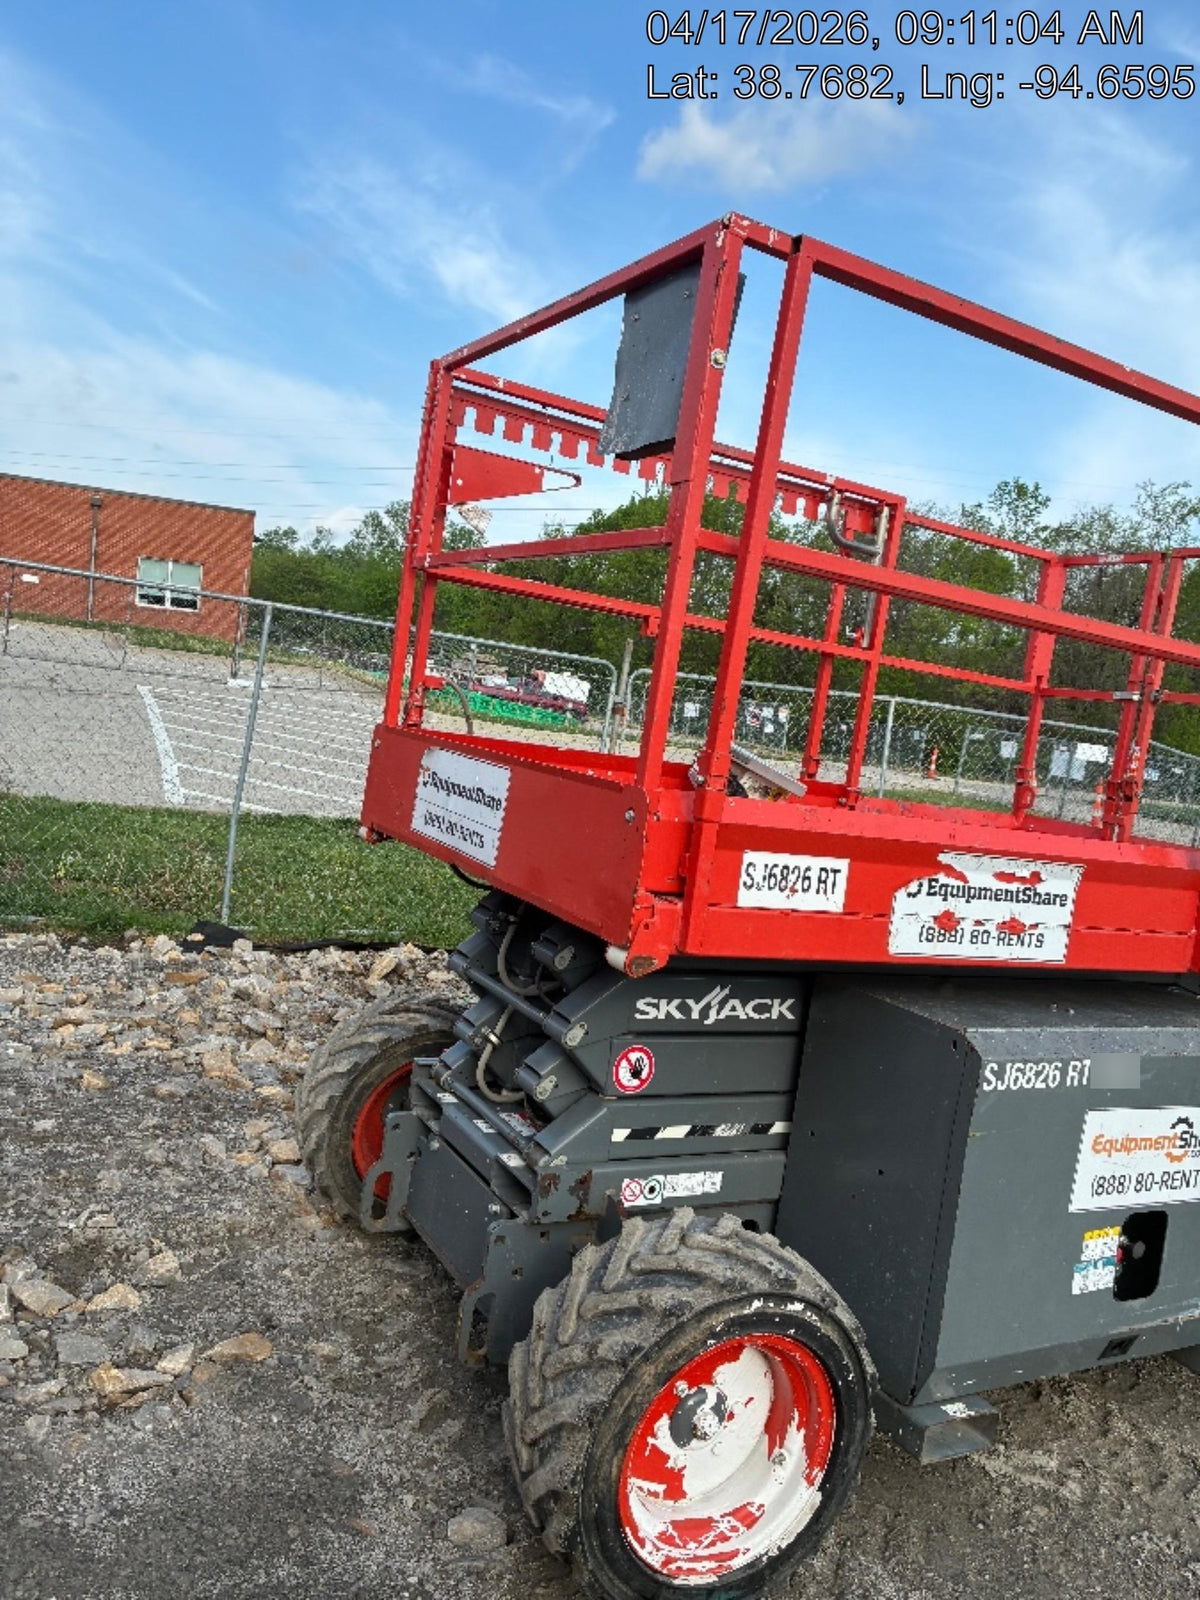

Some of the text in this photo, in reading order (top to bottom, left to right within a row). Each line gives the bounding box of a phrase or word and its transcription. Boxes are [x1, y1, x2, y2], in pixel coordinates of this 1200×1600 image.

[816, 866, 842, 896] RT
[926, 878, 1068, 907] EquipmentShare
[969, 929, 1045, 948] 80-RENTS
[634, 984, 796, 1025] SKYJACK
[982, 1061, 1062, 1091] SJ6826
[1091, 1130, 1200, 1157] EquipmentSh
[1091, 1173, 1132, 1198] (888)
